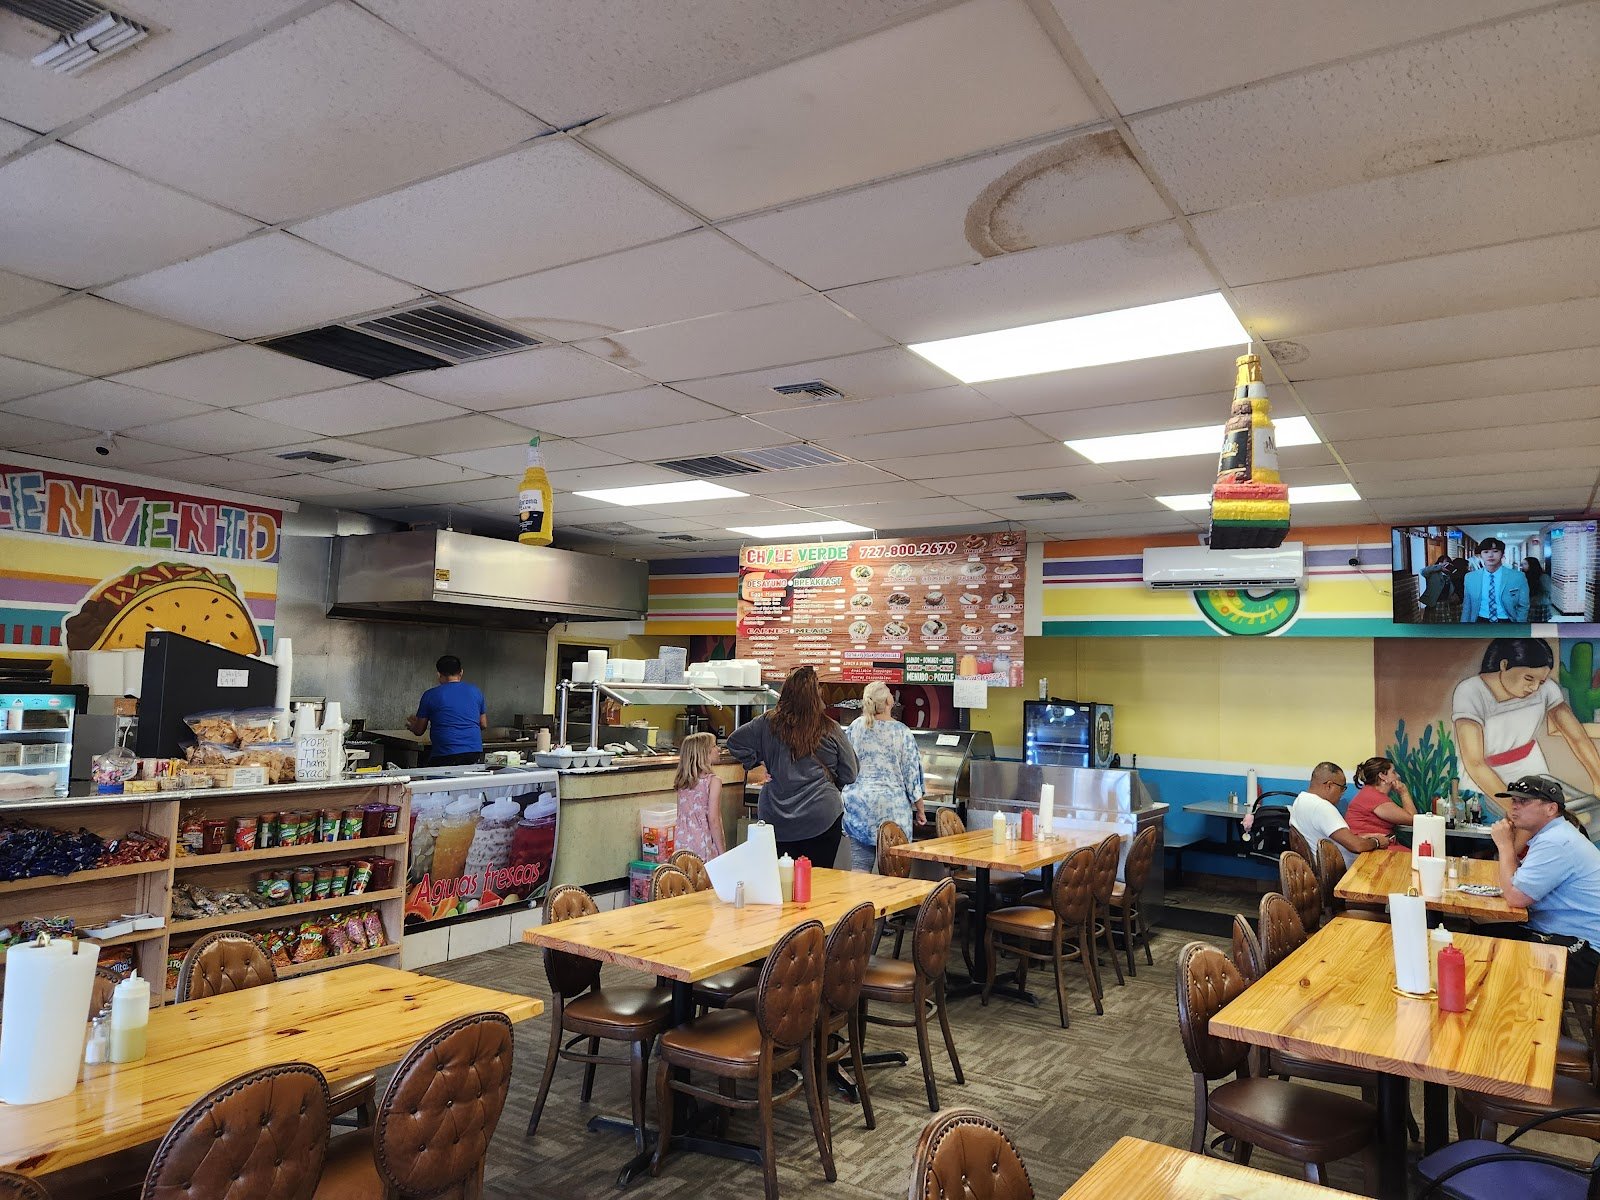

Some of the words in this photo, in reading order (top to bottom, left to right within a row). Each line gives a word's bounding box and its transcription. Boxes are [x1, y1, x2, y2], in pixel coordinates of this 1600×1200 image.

[746, 547, 793, 565] CHILE
[798, 546, 848, 562] VERDE
[859, 542, 957, 559] 727.800.2679
[746, 578, 788, 588] DESAYUNO
[793, 577, 843, 587] BREAKFAST
[906, 672, 928, 682] MENUDO
[933, 672, 954, 682] POZOLE
[413, 873, 478, 907] Aguas
[480, 862, 540, 891] frescas
